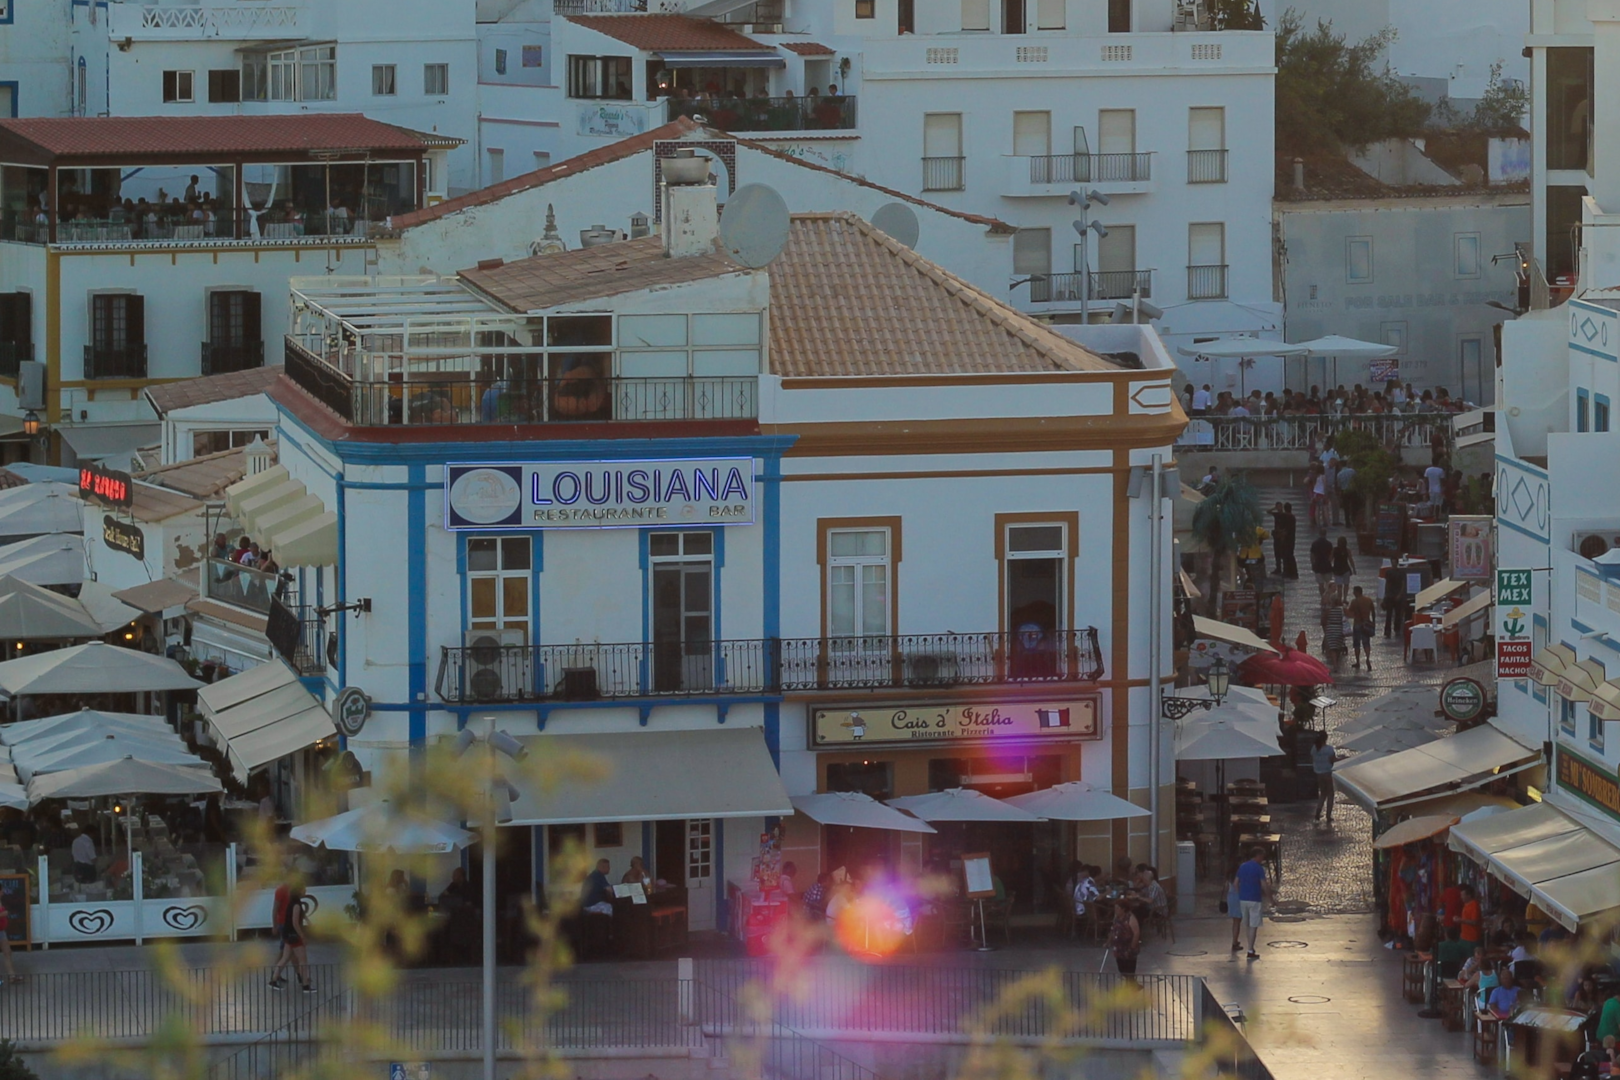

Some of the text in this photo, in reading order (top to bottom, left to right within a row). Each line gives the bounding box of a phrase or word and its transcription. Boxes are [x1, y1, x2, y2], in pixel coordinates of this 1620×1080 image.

[1345, 296, 1374, 310] FOR
[1416, 293, 1445, 307] BAR
[531, 467, 748, 505] LOUISIANA
[533, 503, 746, 521] RESTAURANTE BAR
[1501, 573, 1528, 586] TEX
[1499, 588, 1530, 601] MEX
[1502, 645, 1528, 653] TACOS
[1500, 655, 1530, 664] FAJITAS
[1499, 667, 1530, 675] NACHOS
[1446, 696, 1478, 704] Heineken
[891, 707, 1014, 730] Cais d' Itália
[910, 727, 995, 738] Ristorante Pizzeria
